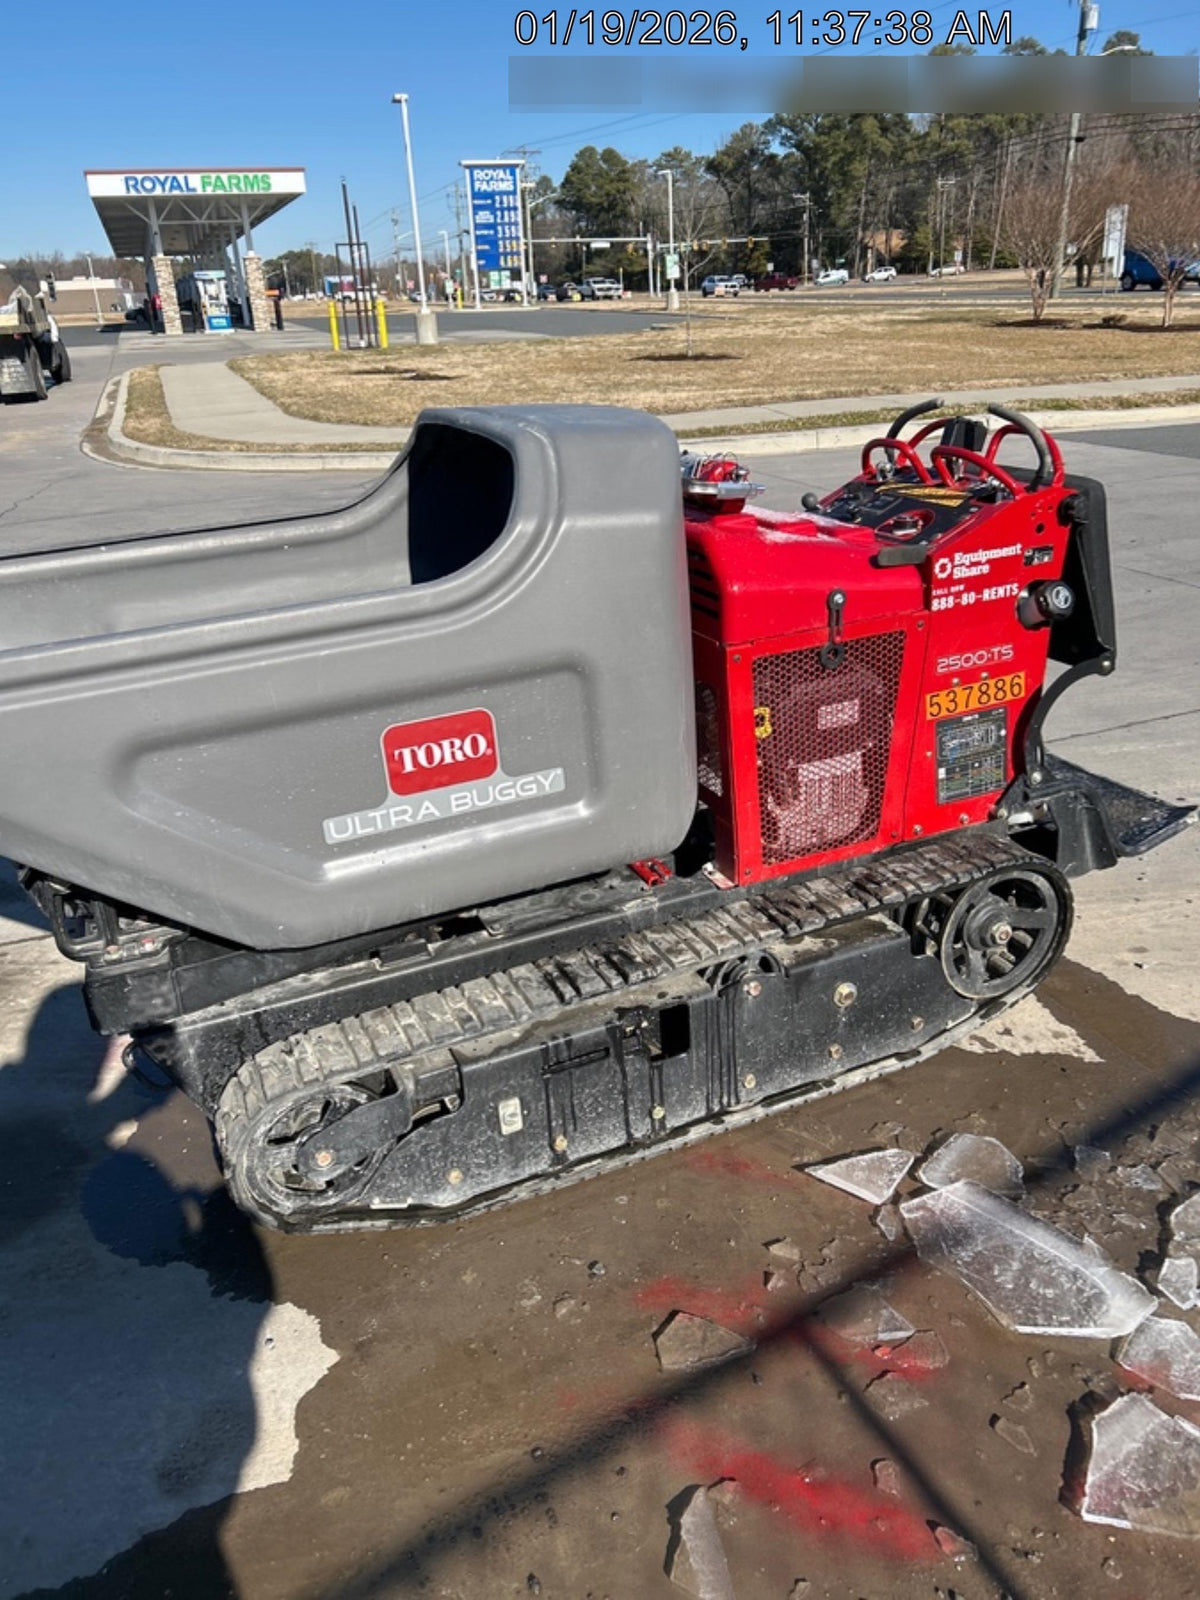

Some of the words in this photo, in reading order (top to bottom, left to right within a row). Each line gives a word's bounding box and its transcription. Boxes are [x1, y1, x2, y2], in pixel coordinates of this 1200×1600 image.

[124, 175, 197, 194] ROYAL
[200, 173, 272, 192] FARMS
[473, 169, 513, 180] ROYAL
[474, 181, 514, 192] FARMS
[953, 543, 1022, 565] Equipment
[952, 564, 990, 579] Share
[931, 583, 1019, 612] 888-80-RENTS
[928, 674, 1024, 718] 537886
[394, 732, 490, 774] TORO
[328, 799, 440, 838] ULTRA
[450, 774, 556, 813] BUGGY
